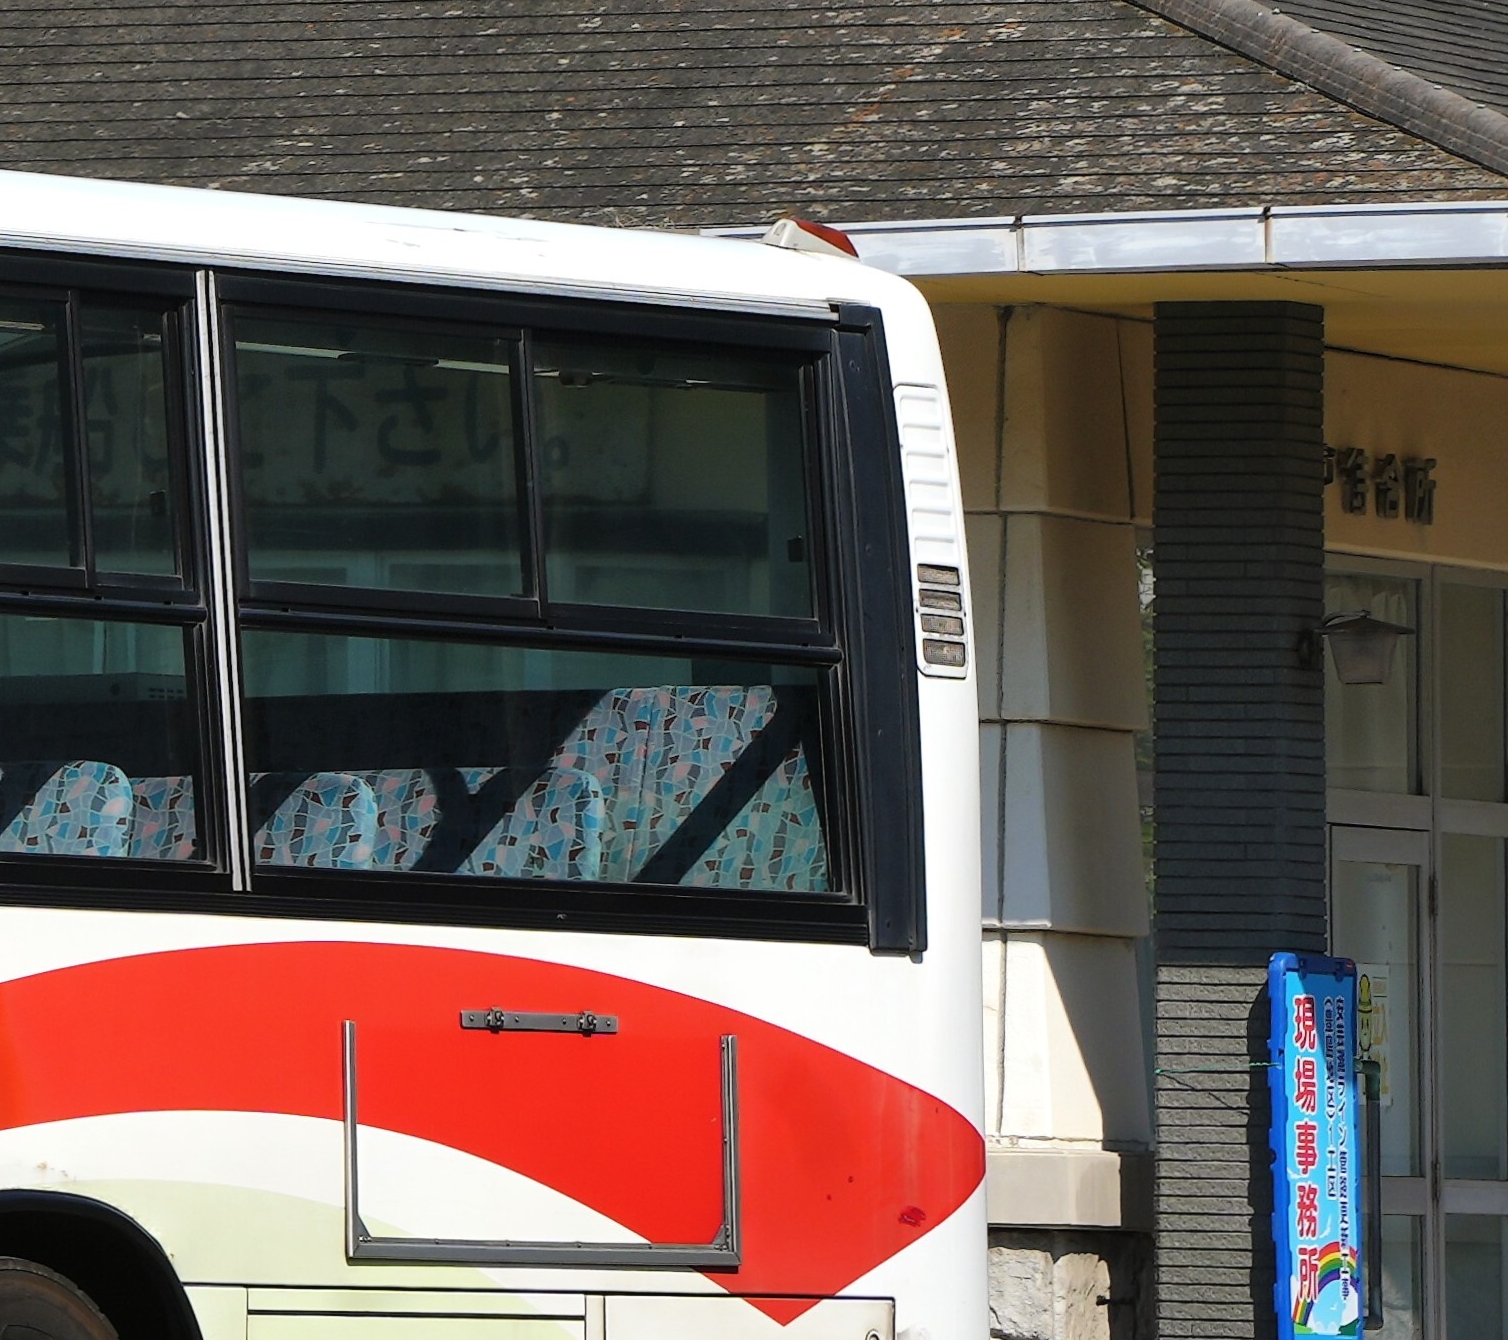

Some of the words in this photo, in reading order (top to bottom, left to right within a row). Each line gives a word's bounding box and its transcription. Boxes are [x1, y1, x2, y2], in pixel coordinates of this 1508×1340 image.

[1294, 995, 1319, 1301] 現場事務所
